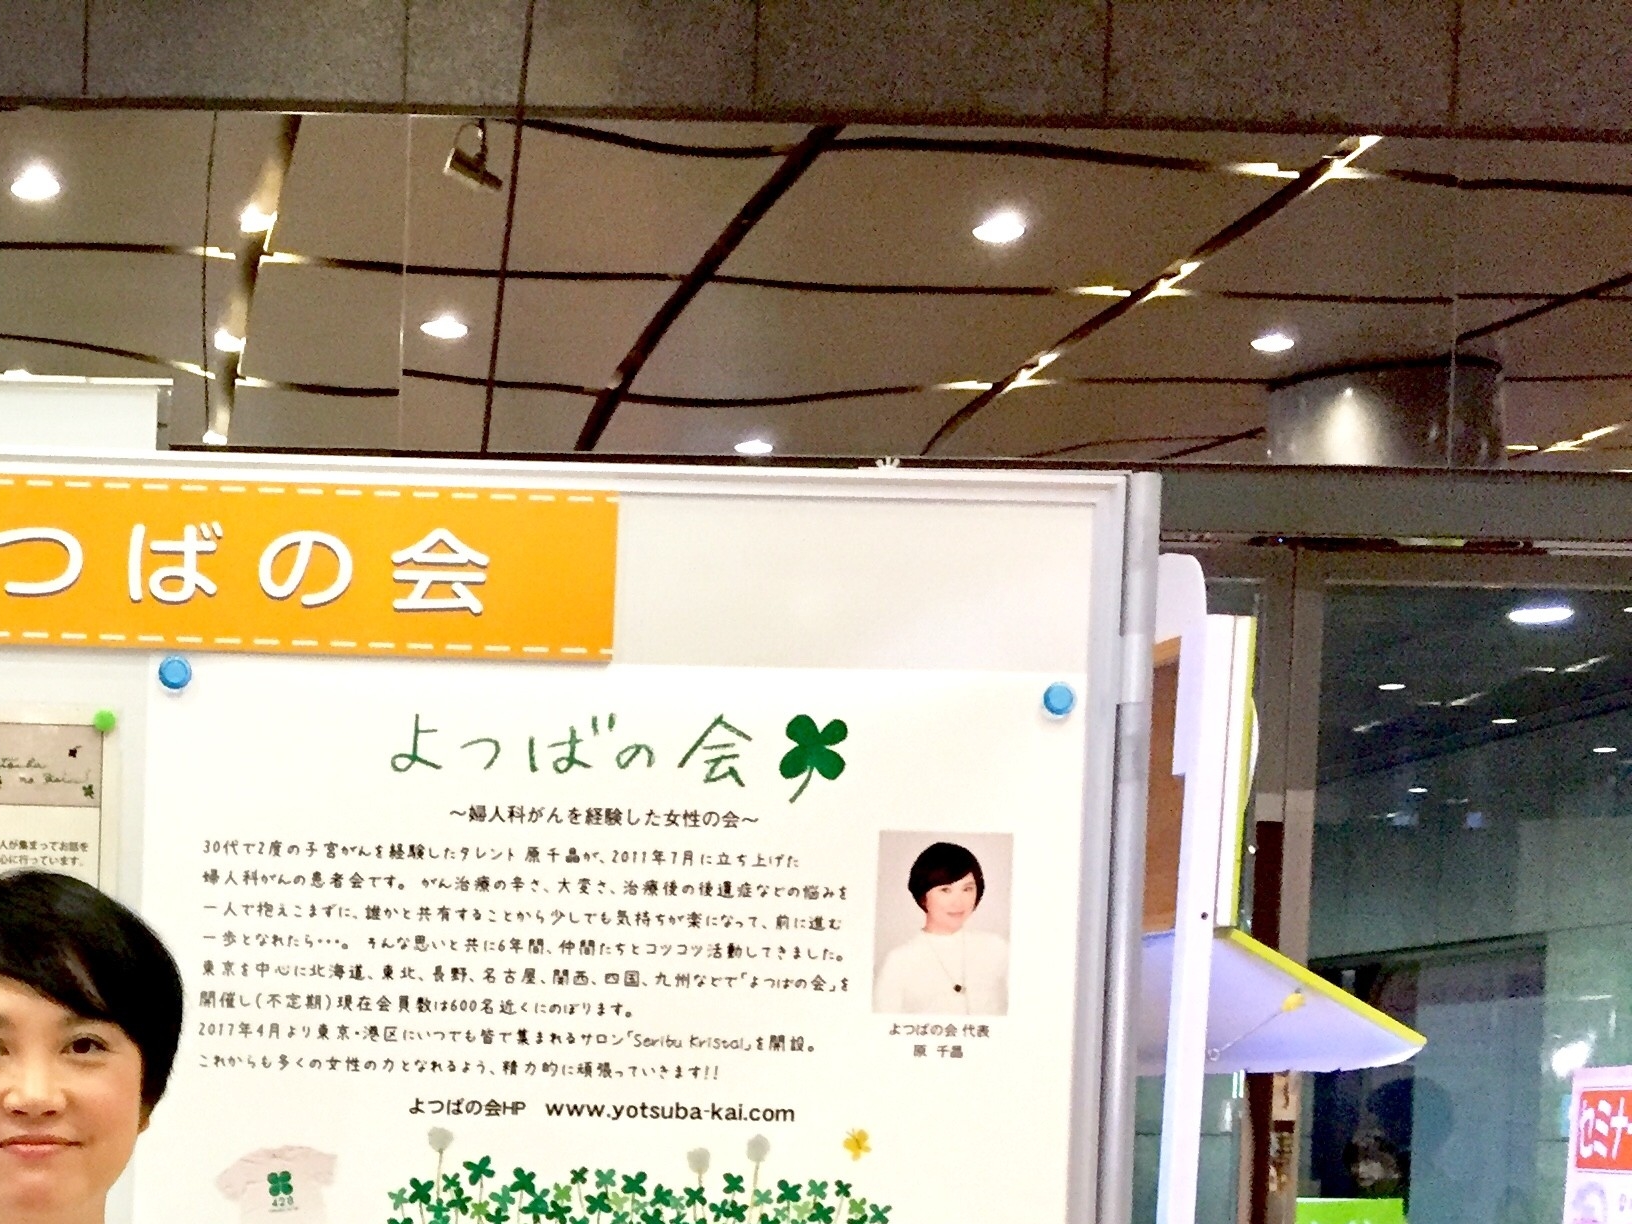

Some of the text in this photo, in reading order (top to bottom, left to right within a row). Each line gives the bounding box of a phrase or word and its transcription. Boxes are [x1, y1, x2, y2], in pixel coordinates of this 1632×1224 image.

[390, 713, 754, 787] よつばの会
[545, 1101, 795, 1123] www.yotsuba-kai.com
